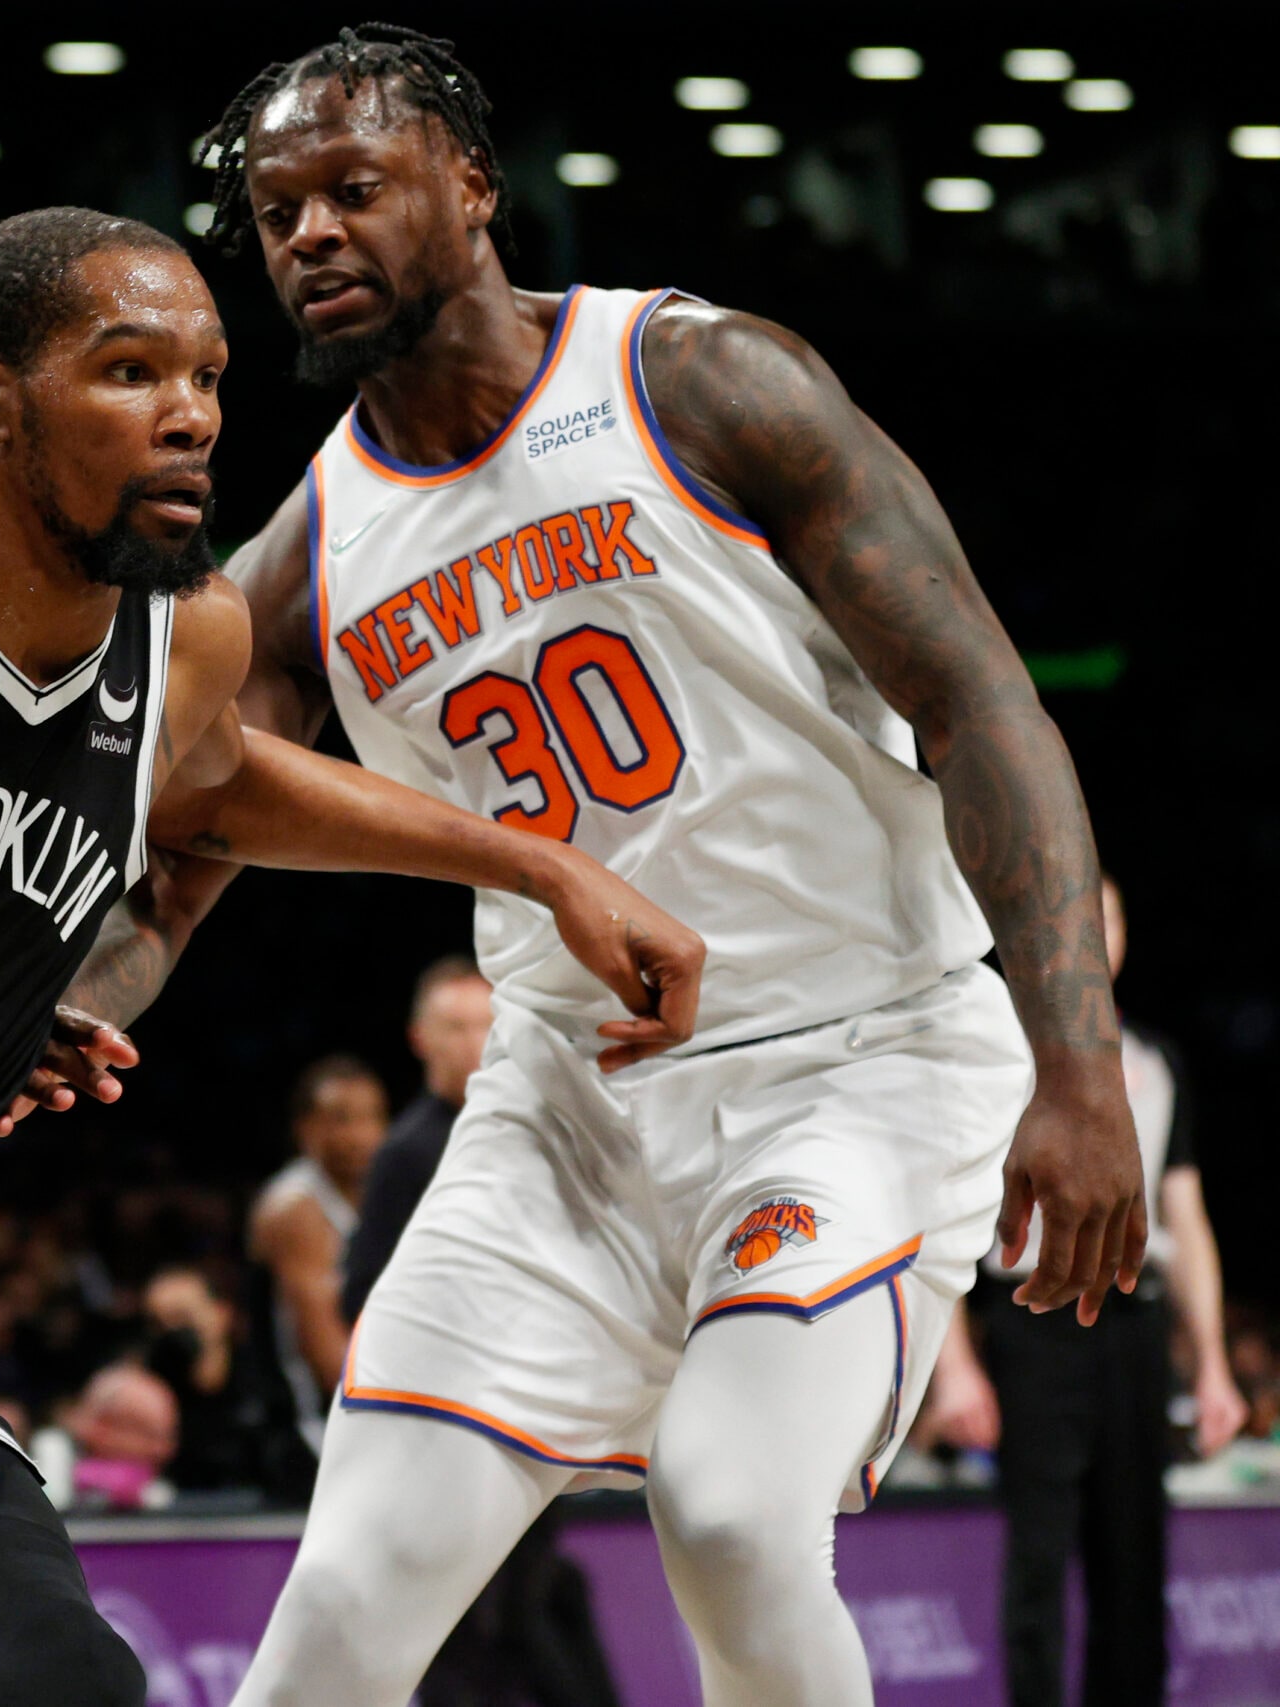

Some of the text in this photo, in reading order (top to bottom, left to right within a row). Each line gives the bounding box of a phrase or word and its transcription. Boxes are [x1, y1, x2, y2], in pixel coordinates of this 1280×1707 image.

[526, 399, 612, 441] SQUARE
[528, 423, 597, 458] SPACE
[335, 500, 658, 704] NEW YORK
[91, 731, 132, 755] Webull
[439, 623, 687, 844] 30
